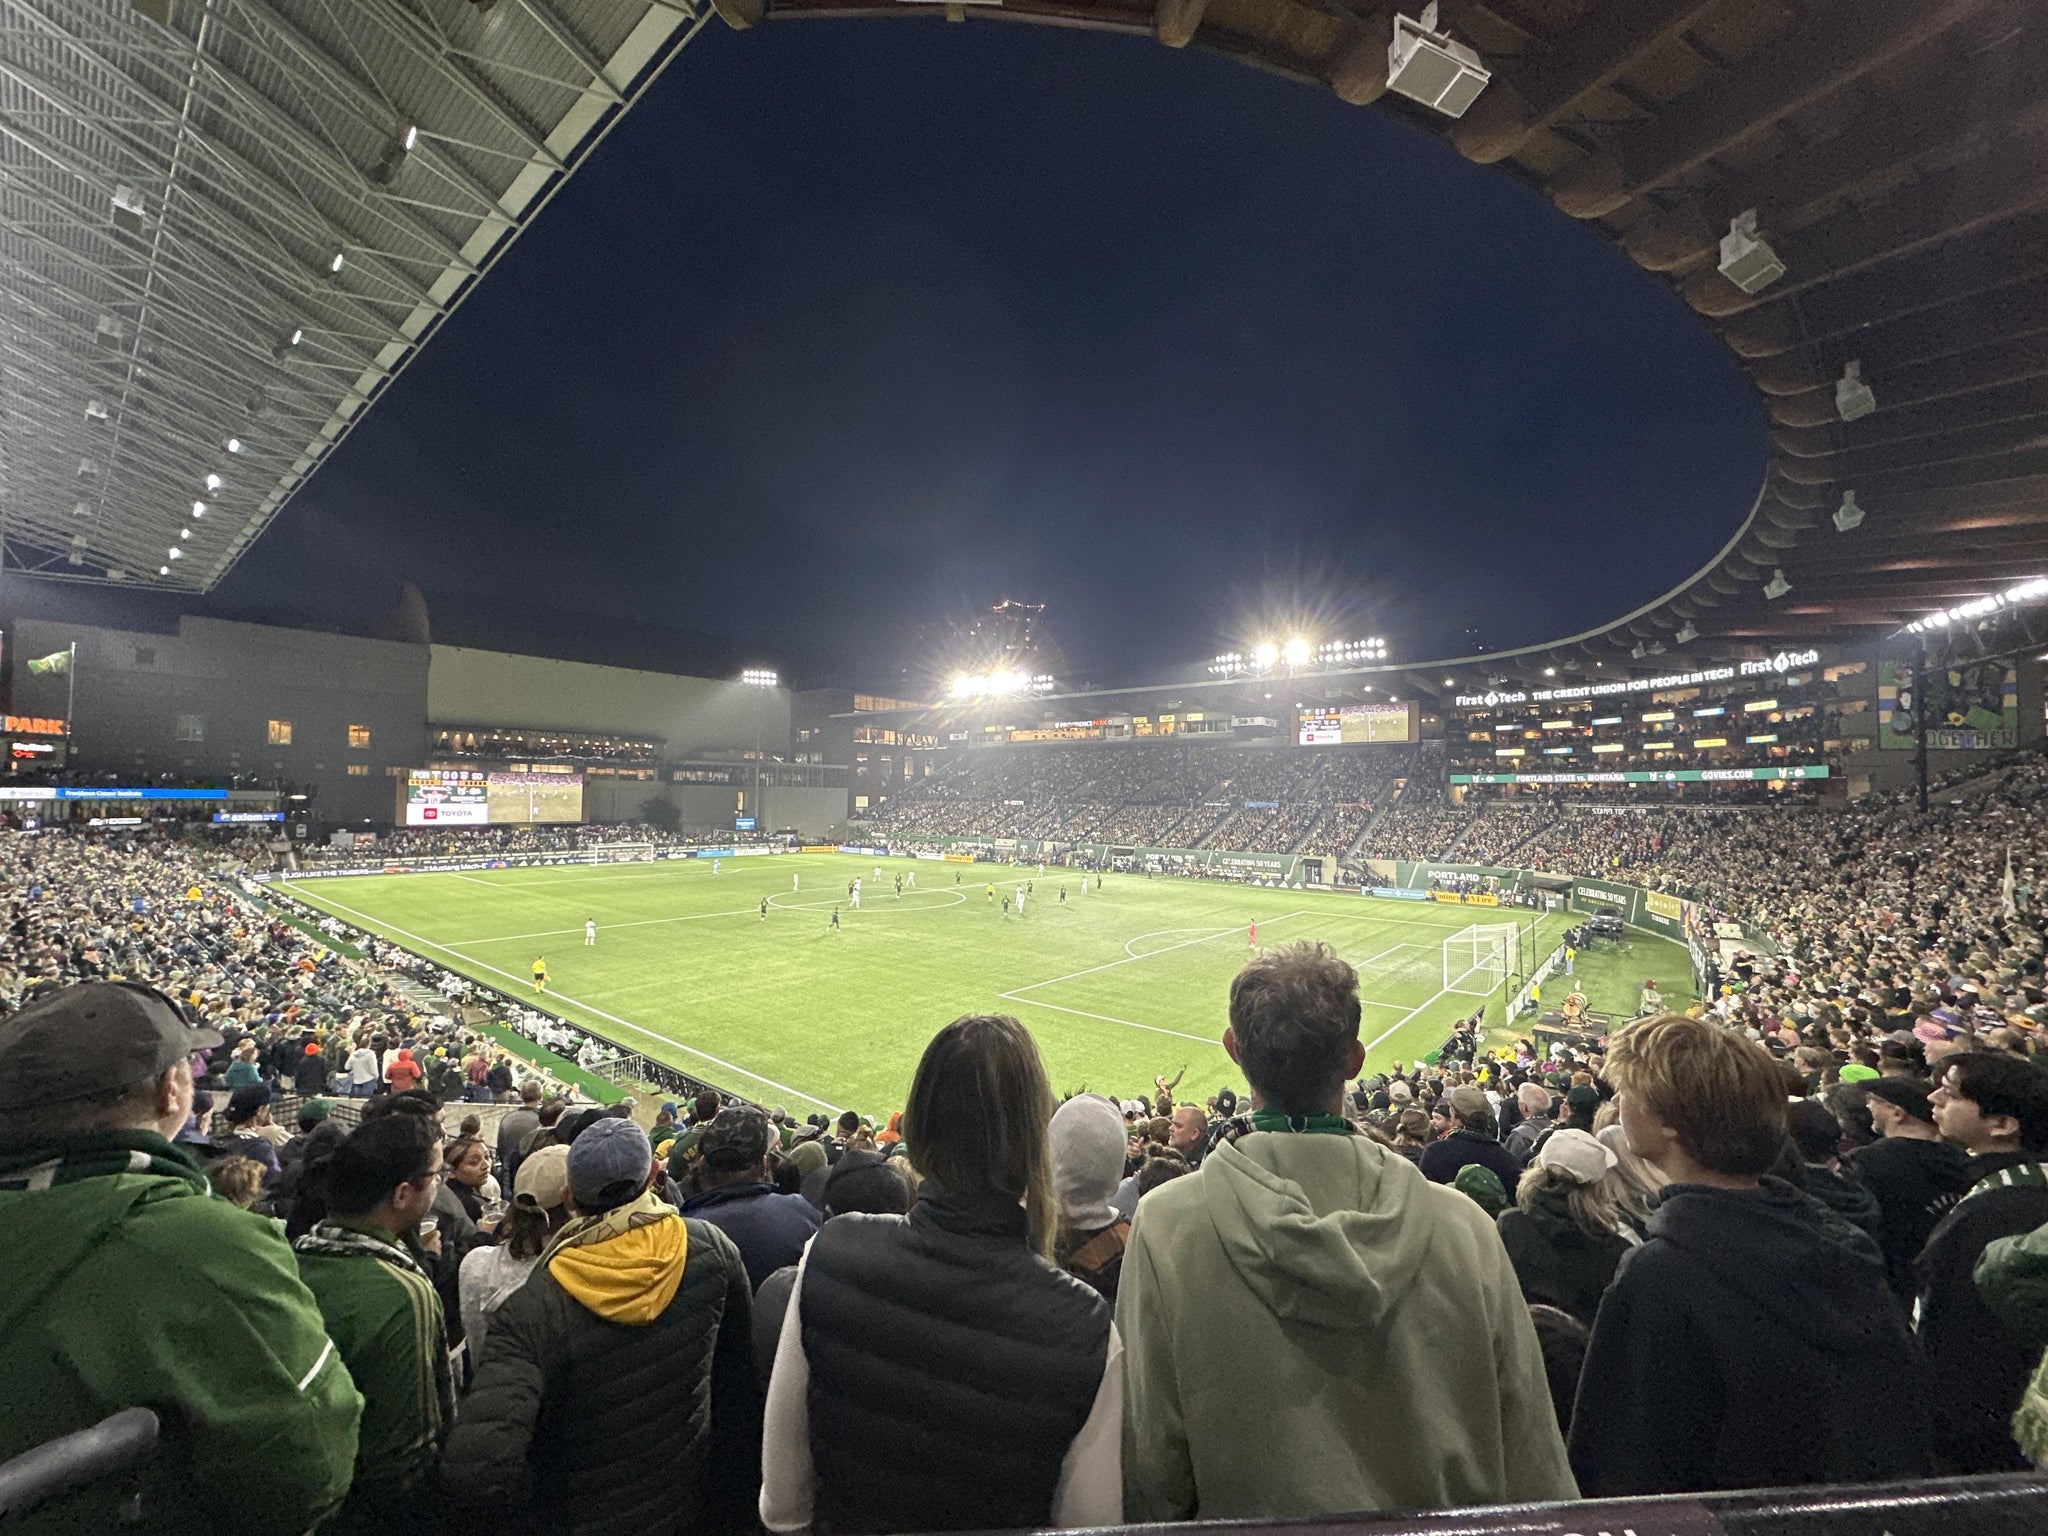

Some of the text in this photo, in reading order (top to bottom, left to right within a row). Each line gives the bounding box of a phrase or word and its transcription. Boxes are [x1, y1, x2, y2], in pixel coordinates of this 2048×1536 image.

[1741, 650, 1818, 675] First Tech
[1532, 667, 1734, 700] THE CREDIT UNION FOR PEOPLE IN TECH
[1455, 691, 1526, 706] First Tech
[5, 715, 64, 735] PARK
[1911, 729, 2014, 746] OGETHER
[1516, 775, 1553, 783] PORTLAND
[1554, 774, 1575, 782] STATE
[1587, 774, 1625, 782] MONTANA
[1701, 770, 1753, 780] GOVIKS.COM
[1427, 870, 1480, 882] PORTLAND
[1577, 886, 1607, 900] CELEBRATING
